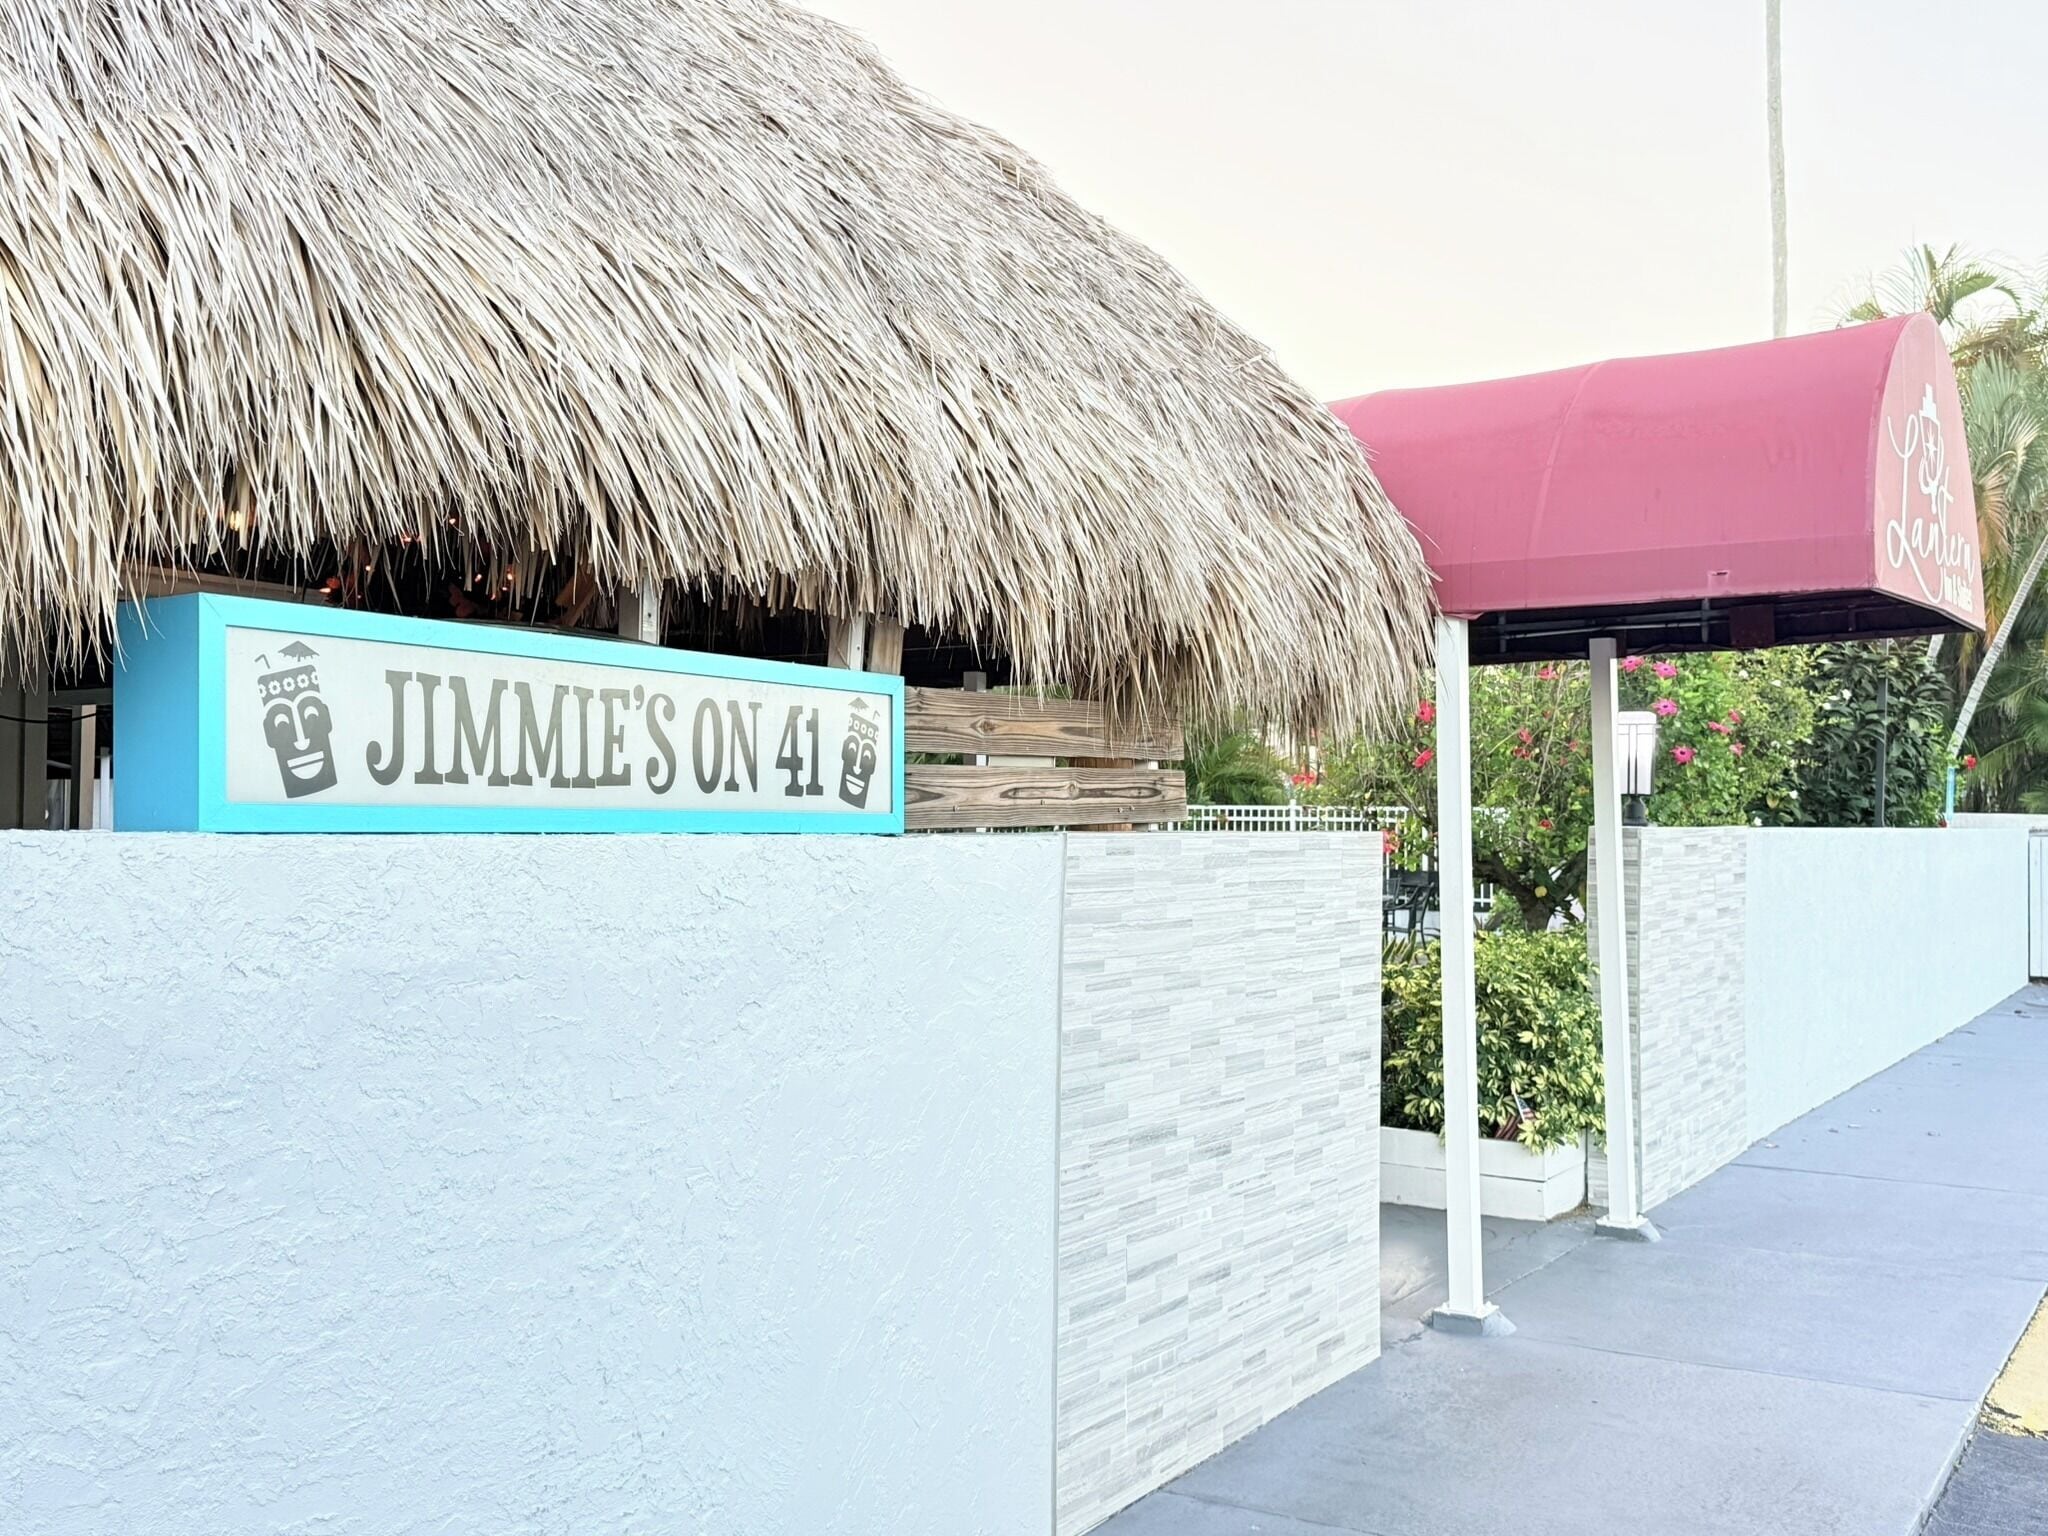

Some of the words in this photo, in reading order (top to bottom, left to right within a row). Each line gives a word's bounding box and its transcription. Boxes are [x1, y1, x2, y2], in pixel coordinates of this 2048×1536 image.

[1887, 414, 1976, 604] Lantern
[365, 669, 678, 795] JIMMIE'S
[692, 697, 763, 794] ON
[775, 705, 824, 797] 41
